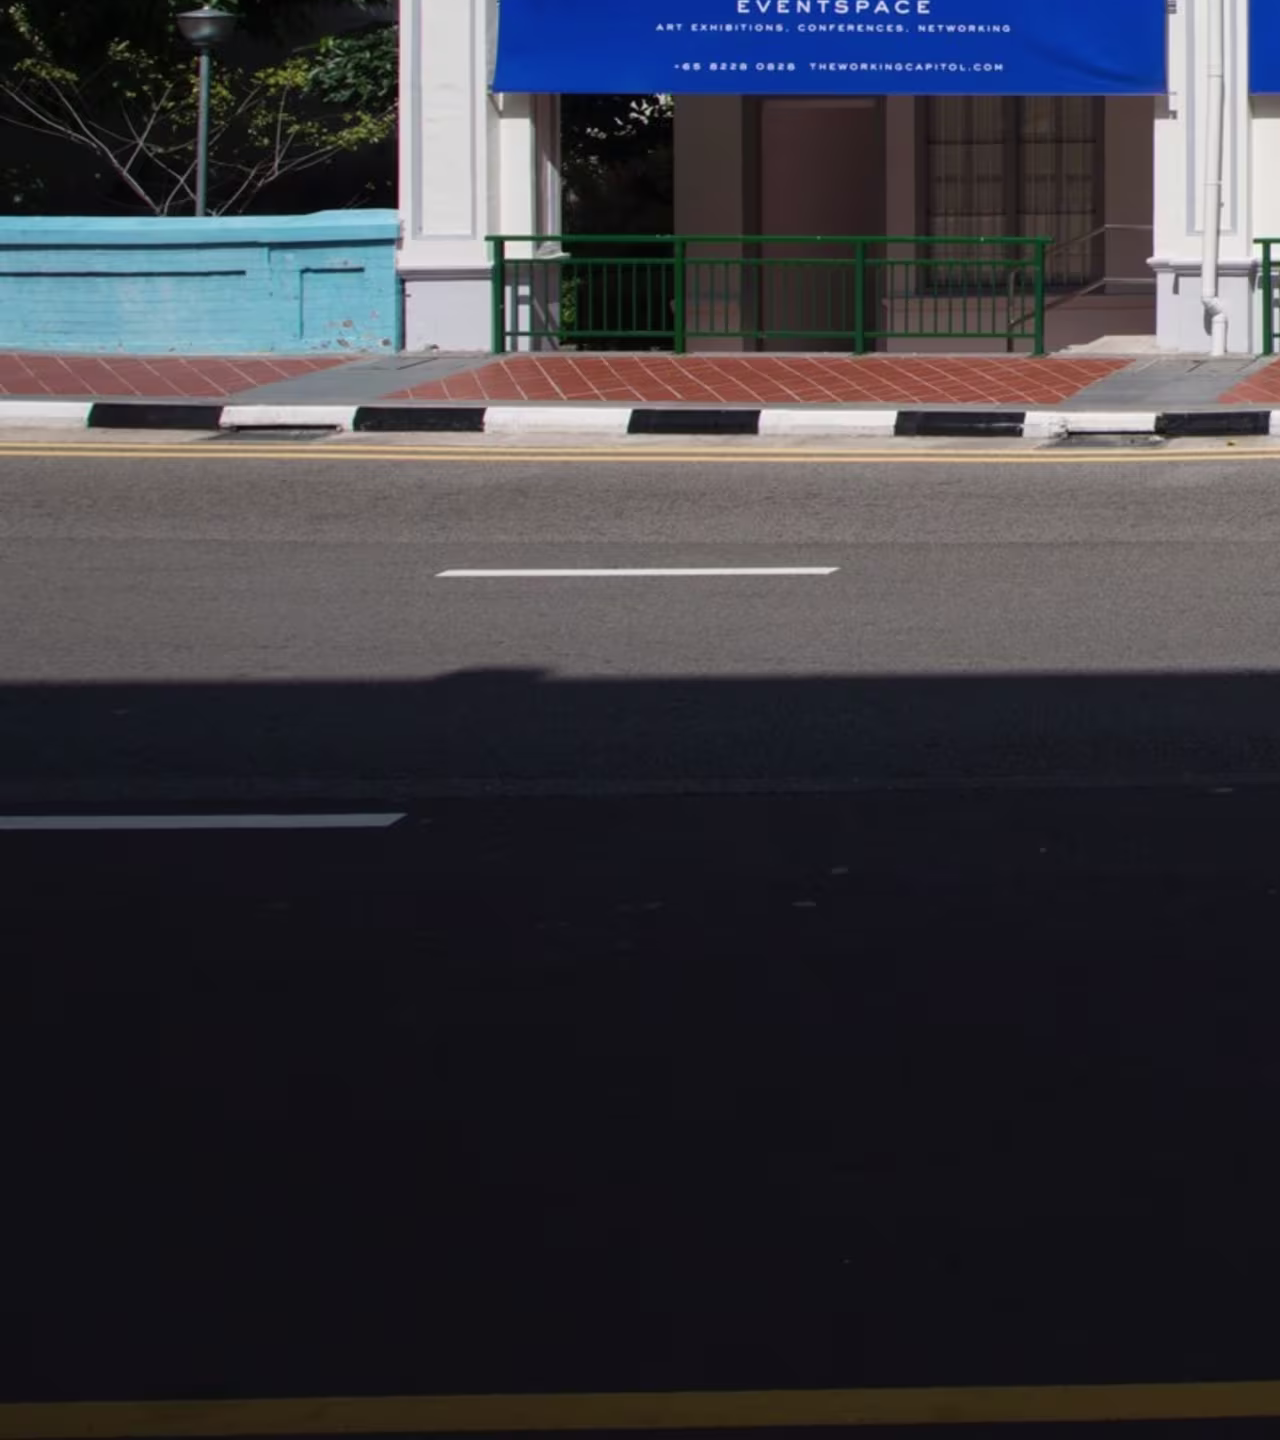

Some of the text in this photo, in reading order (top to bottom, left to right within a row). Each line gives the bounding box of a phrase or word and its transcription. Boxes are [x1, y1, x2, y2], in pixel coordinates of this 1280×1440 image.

[655, 23, 682, 31] ART
[917, 24, 1011, 33] NETWORKING
[809, 62, 1004, 72] THEWORKINGCAPITOL.COM
